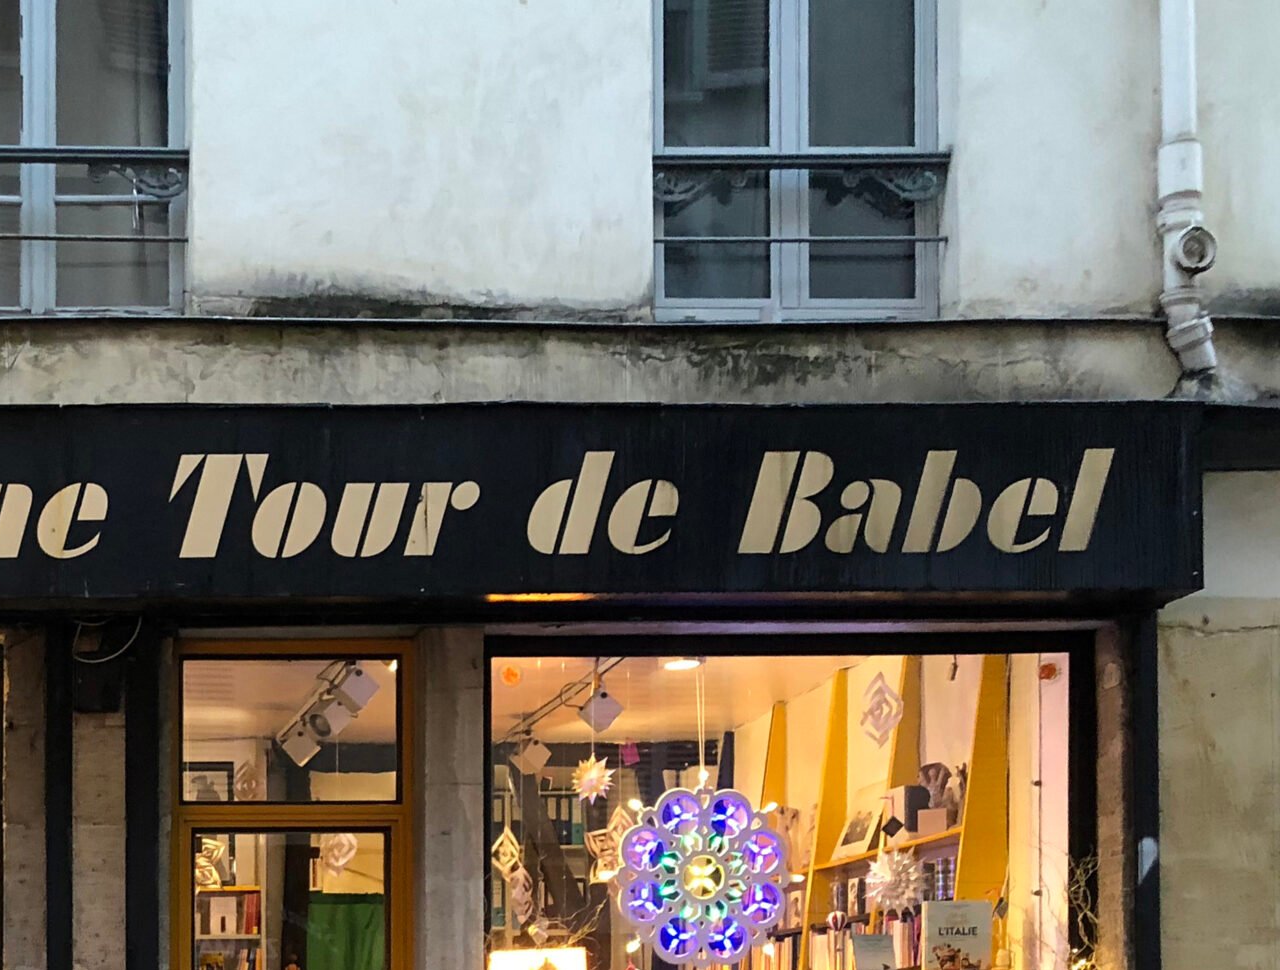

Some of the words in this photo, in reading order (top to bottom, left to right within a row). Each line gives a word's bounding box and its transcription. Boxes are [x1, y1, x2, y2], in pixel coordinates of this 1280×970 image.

[168, 453, 480, 559] Tour
[526, 450, 680, 556] de
[737, 447, 1116, 555] Babel
[938, 926, 978, 936] L'ITALIE
